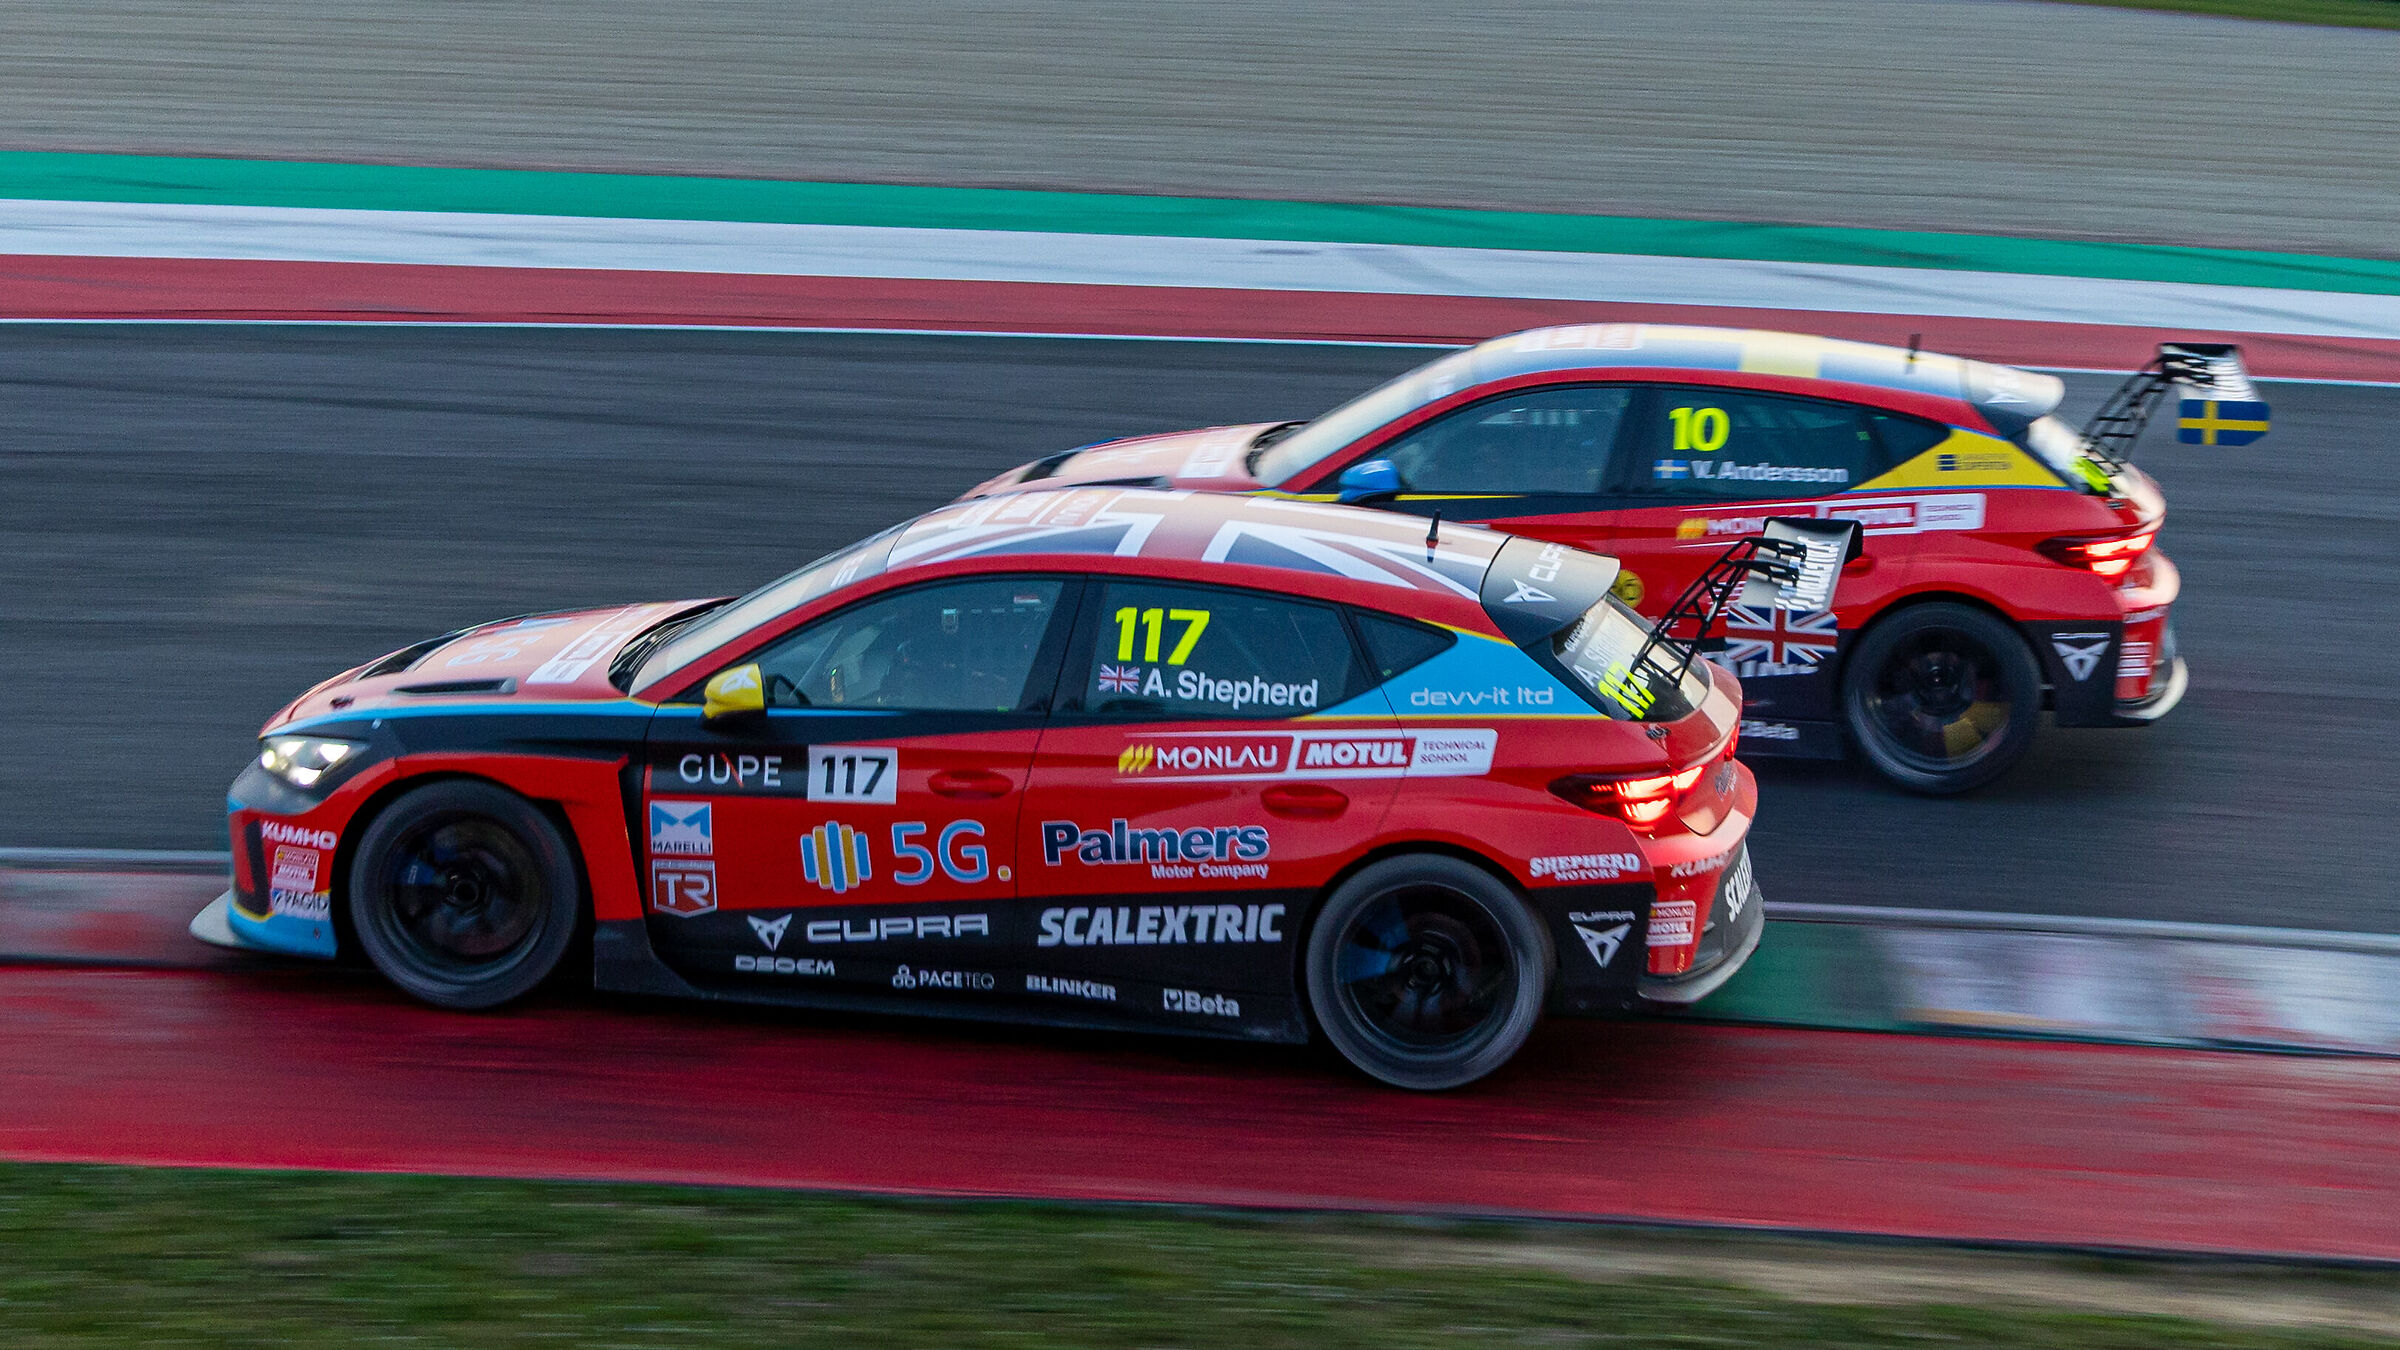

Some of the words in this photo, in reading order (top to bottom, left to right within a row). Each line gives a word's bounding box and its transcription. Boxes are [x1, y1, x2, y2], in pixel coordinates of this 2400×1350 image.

[1669, 407, 1730, 451] 10
[1691, 460, 1716, 479] V.
[1716, 460, 1849, 482] Andersson
[1116, 607, 1210, 665] 117
[1143, 668, 1172, 698] A.
[1177, 670, 1319, 710] Shepherd
[1517, 686, 1554, 705] ltd
[1598, 661, 1657, 719] 117
[1157, 745, 1278, 770] MONLAU
[1304, 742, 1408, 766] MOTUL
[1420, 753, 1468, 763] SCHOOL
[1423, 740, 1487, 751] TECHNICAL
[822, 755, 889, 796] 117
[262, 821, 338, 850] KUMHO
[652, 840, 712, 854] MARELLI
[1041, 818, 1270, 867] Palmers
[1151, 863, 1196, 879] Motor
[1198, 862, 1270, 880] Company
[1529, 852, 1641, 878] SHEPHERD
[1554, 867, 1621, 881] MOTORS
[658, 872, 711, 907] TR
[807, 914, 990, 943] CUPRA
[1037, 903, 1287, 947] SCALEXTRIC
[919, 968, 996, 990] PACETEQ
[1026, 974, 1117, 1001] BLINKER
[1184, 990, 1241, 1017] Beta
